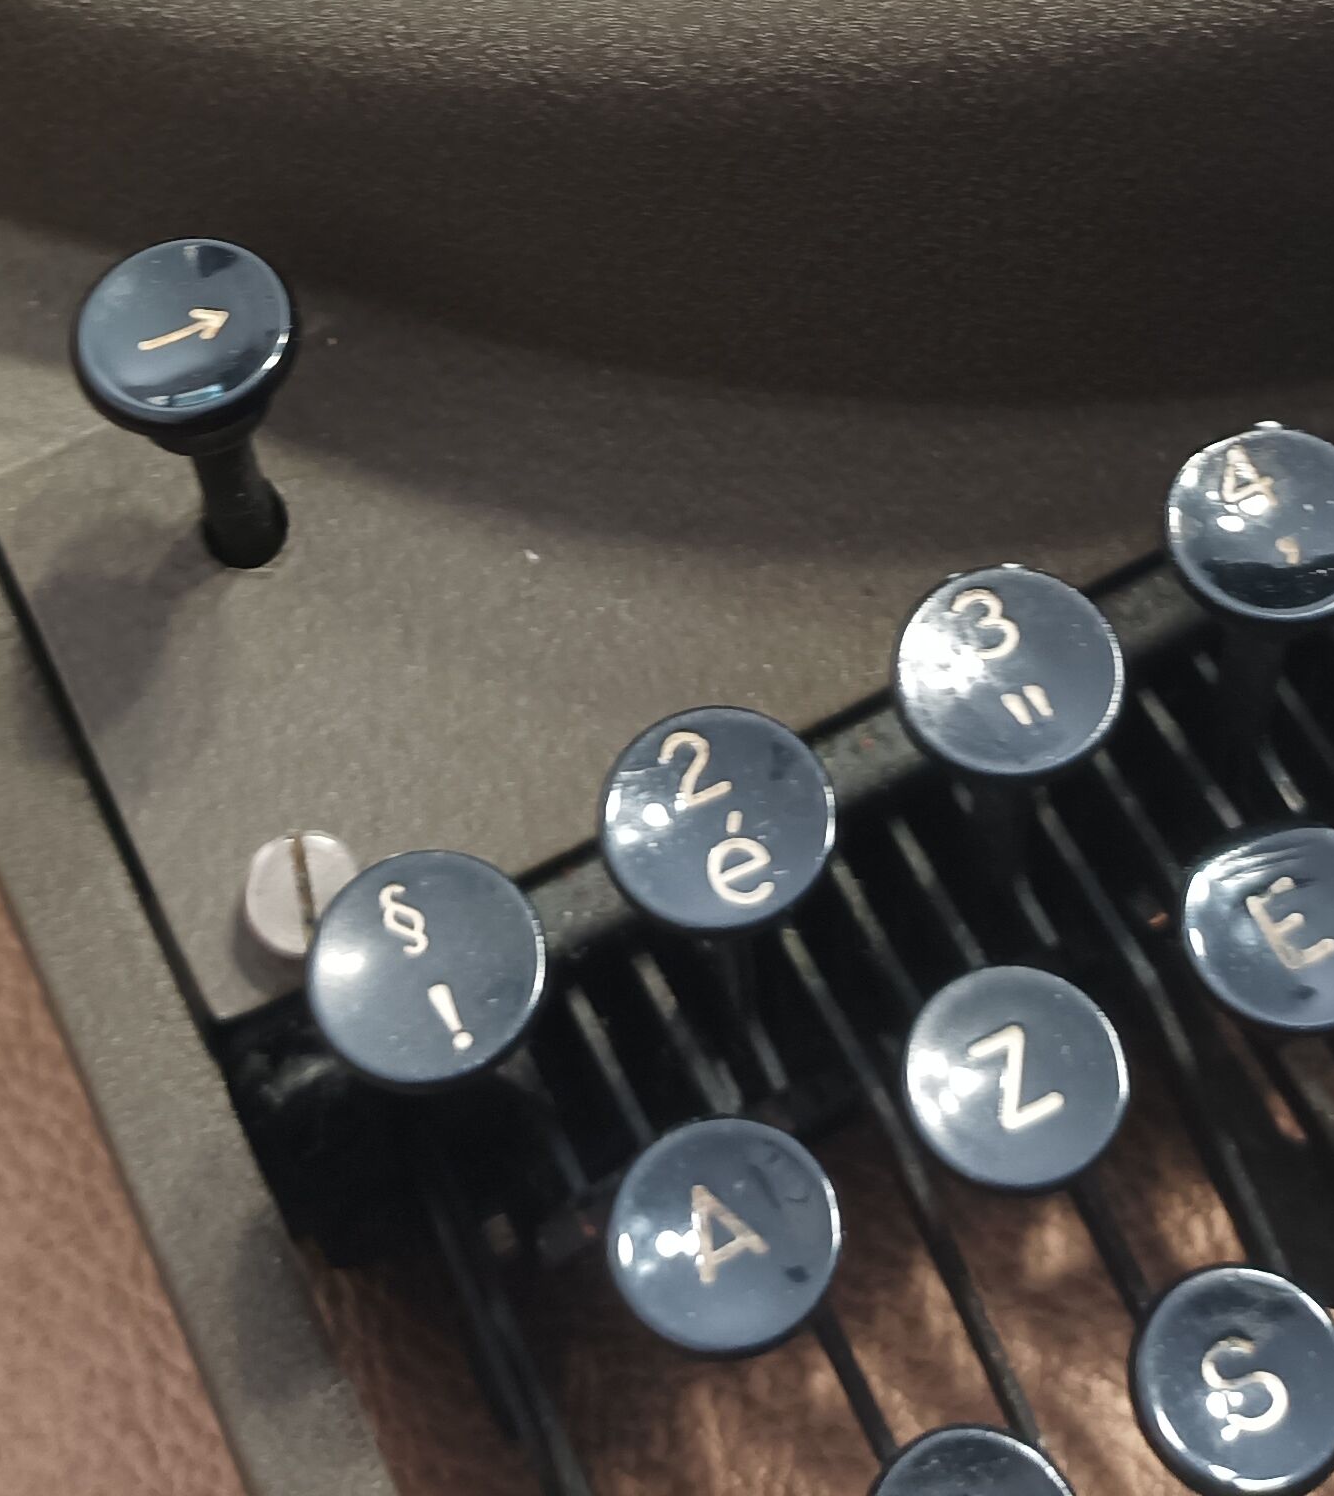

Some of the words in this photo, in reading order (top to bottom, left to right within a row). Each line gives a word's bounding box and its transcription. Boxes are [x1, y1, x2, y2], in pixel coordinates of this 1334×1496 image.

[1222, 444, 1279, 507] 4
[950, 587, 1020, 660] 3
[657, 730, 734, 806] 2
[706, 810, 776, 905] é
[427, 982, 475, 1051] !
[967, 1023, 1066, 1132] Z
[690, 1184, 769, 1286] A
[1199, 1335, 1290, 1436] S
